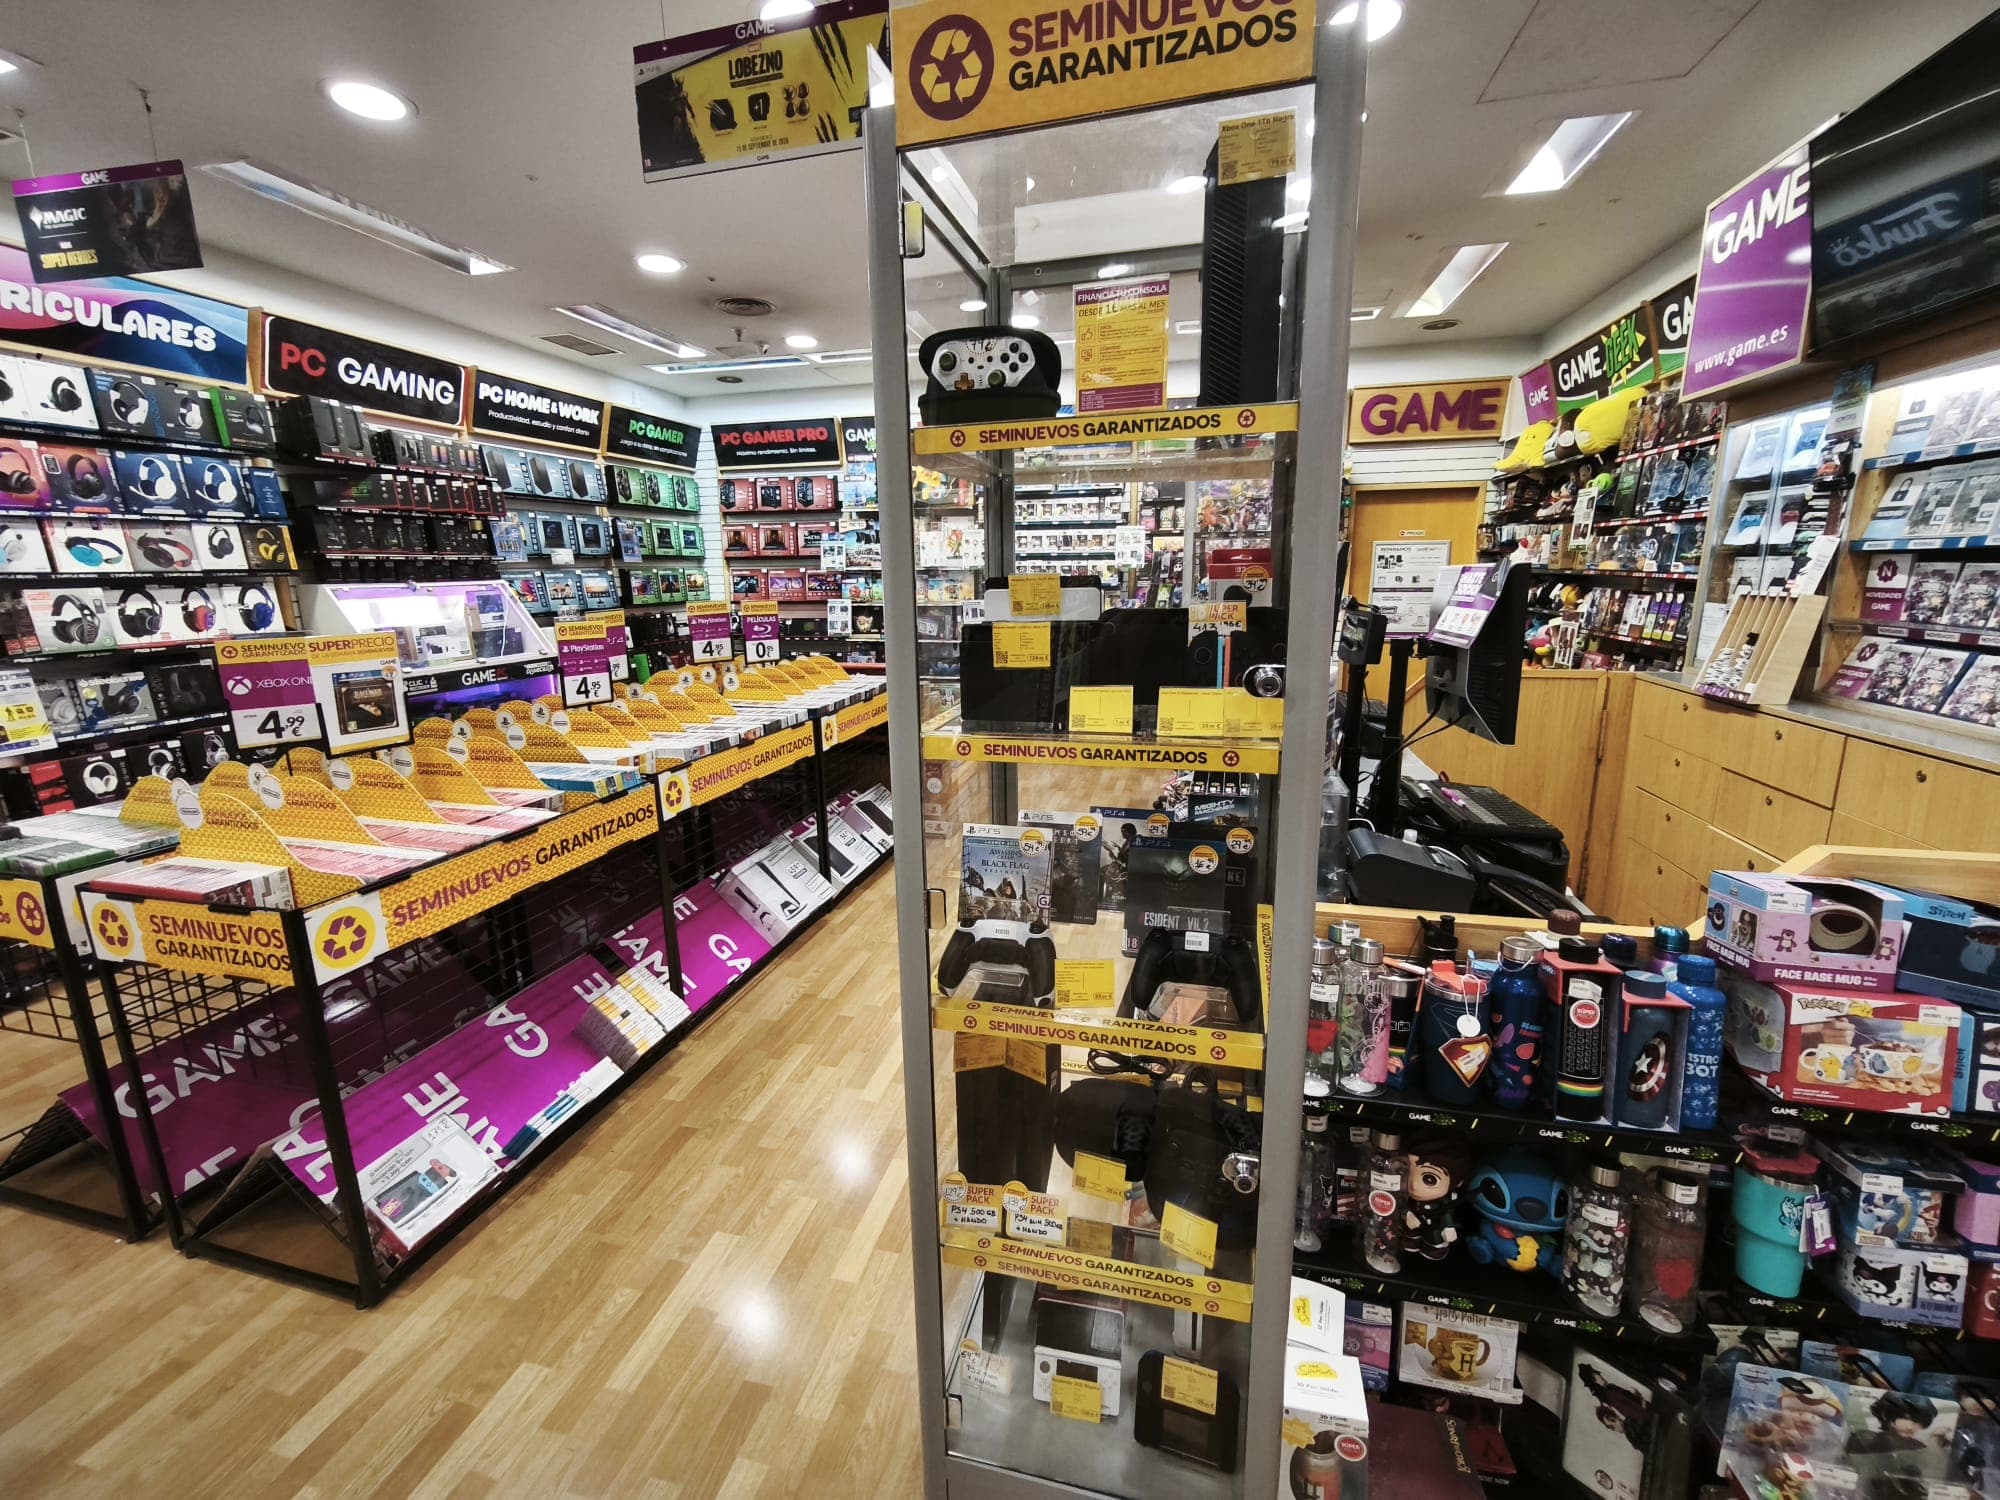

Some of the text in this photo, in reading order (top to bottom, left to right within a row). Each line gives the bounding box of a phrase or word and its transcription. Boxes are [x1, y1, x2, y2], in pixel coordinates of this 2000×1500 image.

[735, 19, 775, 40] GAME
[1009, 0, 1293, 57] SEMINUEV
[1009, 9, 1297, 91] GARANTIZADOS
[728, 50, 783, 81] LOBEZNO
[81, 170, 109, 185] GAME
[43, 207, 87, 225] MAGIC
[1710, 163, 1811, 264] GAME
[41, 249, 98, 269] SUPER HEROES
[1078, 307, 1102, 317] DESDE
[1149, 300, 1166, 308] MES
[1605, 315, 1640, 381] GEEK
[1693, 323, 1788, 374] www.game.es
[280, 343, 455, 405] PC GAMING
[1557, 344, 1602, 392] GAME
[1529, 385, 1549, 406] GAME
[479, 383, 600, 426] PC HOME & WORK
[1361, 388, 1503, 435] GAME
[629, 419, 684, 445] PC GAMER
[720, 427, 828, 446] PC GAMER PRO
[980, 414, 1221, 443] SEMINUEVOS GARANTIZADOS
[1865, 592, 1902, 600] NOVEDADES
[1871, 602, 1891, 611] GAME
[698, 617, 727, 625] PlayStation
[747, 615, 776, 623] PELÍCULAS
[241, 642, 306, 652] SEMINUEVO
[309, 636, 395, 653] SUPERPRECIO
[570, 644, 605, 653] PlayStation
[242, 650, 307, 658] GARANTIZADO
[257, 678, 290, 688] XBOX
[462, 669, 497, 686] GAME
[1836, 679, 1855, 687] GAME
[838, 713, 870, 733] SEMINUEVOS
[984, 743, 1207, 765] SEMINUEVOS GARANTIZADOS
[692, 734, 813, 793] SEMINUEVOS GARANTIZADOS
[418, 768, 462, 777] GARANTIZADOS
[356, 778, 404, 789] GARANTIZADOS
[286, 799, 337, 810] GARANTIZADOS
[1194, 799, 1235, 811] MIGHTY
[205, 817, 259, 829] GARANTIZADOS
[393, 803, 655, 929] SEMINUEVOS GARANTIZADOS
[981, 860, 1030, 870] BLACK FLAG
[1140, 911, 1180, 930] ESIDENT
[149, 915, 285, 949] SEMINUEVOS
[1127, 937, 1138, 948] 18
[155, 938, 291, 971] GARANTIZADOS
[1706, 940, 1750, 969] FACE BASE MUG
[1775, 968, 1862, 985] FACE BASE MUG
[988, 1020, 1197, 1056] SEMINUEVOS GARANTIZADOS
[1409, 1112, 1431, 1122] GAME
[1772, 1106, 1799, 1116] GAME
[1539, 1129, 1563, 1139] GAME
[1911, 1121, 1940, 1132] GAME
[1665, 1145, 1690, 1156] GAME
[966, 1186, 994, 1196] SUPER
[966, 1195, 989, 1205] PACK
[1031, 1196, 1060, 1207] SUPER
[1030, 1205, 1055, 1216] PACK
[1001, 1243, 1194, 1288] SEMINUEVOS GARANTIZADOS
[998, 1261, 1192, 1308] SEMINUEVOS GARANTIZADOS
[1321, 1276, 1342, 1285] GAME
[1427, 1295, 1450, 1305] GAME
[1749, 1297, 1774, 1307] GAME
[1554, 1318, 1577, 1328] GAME
